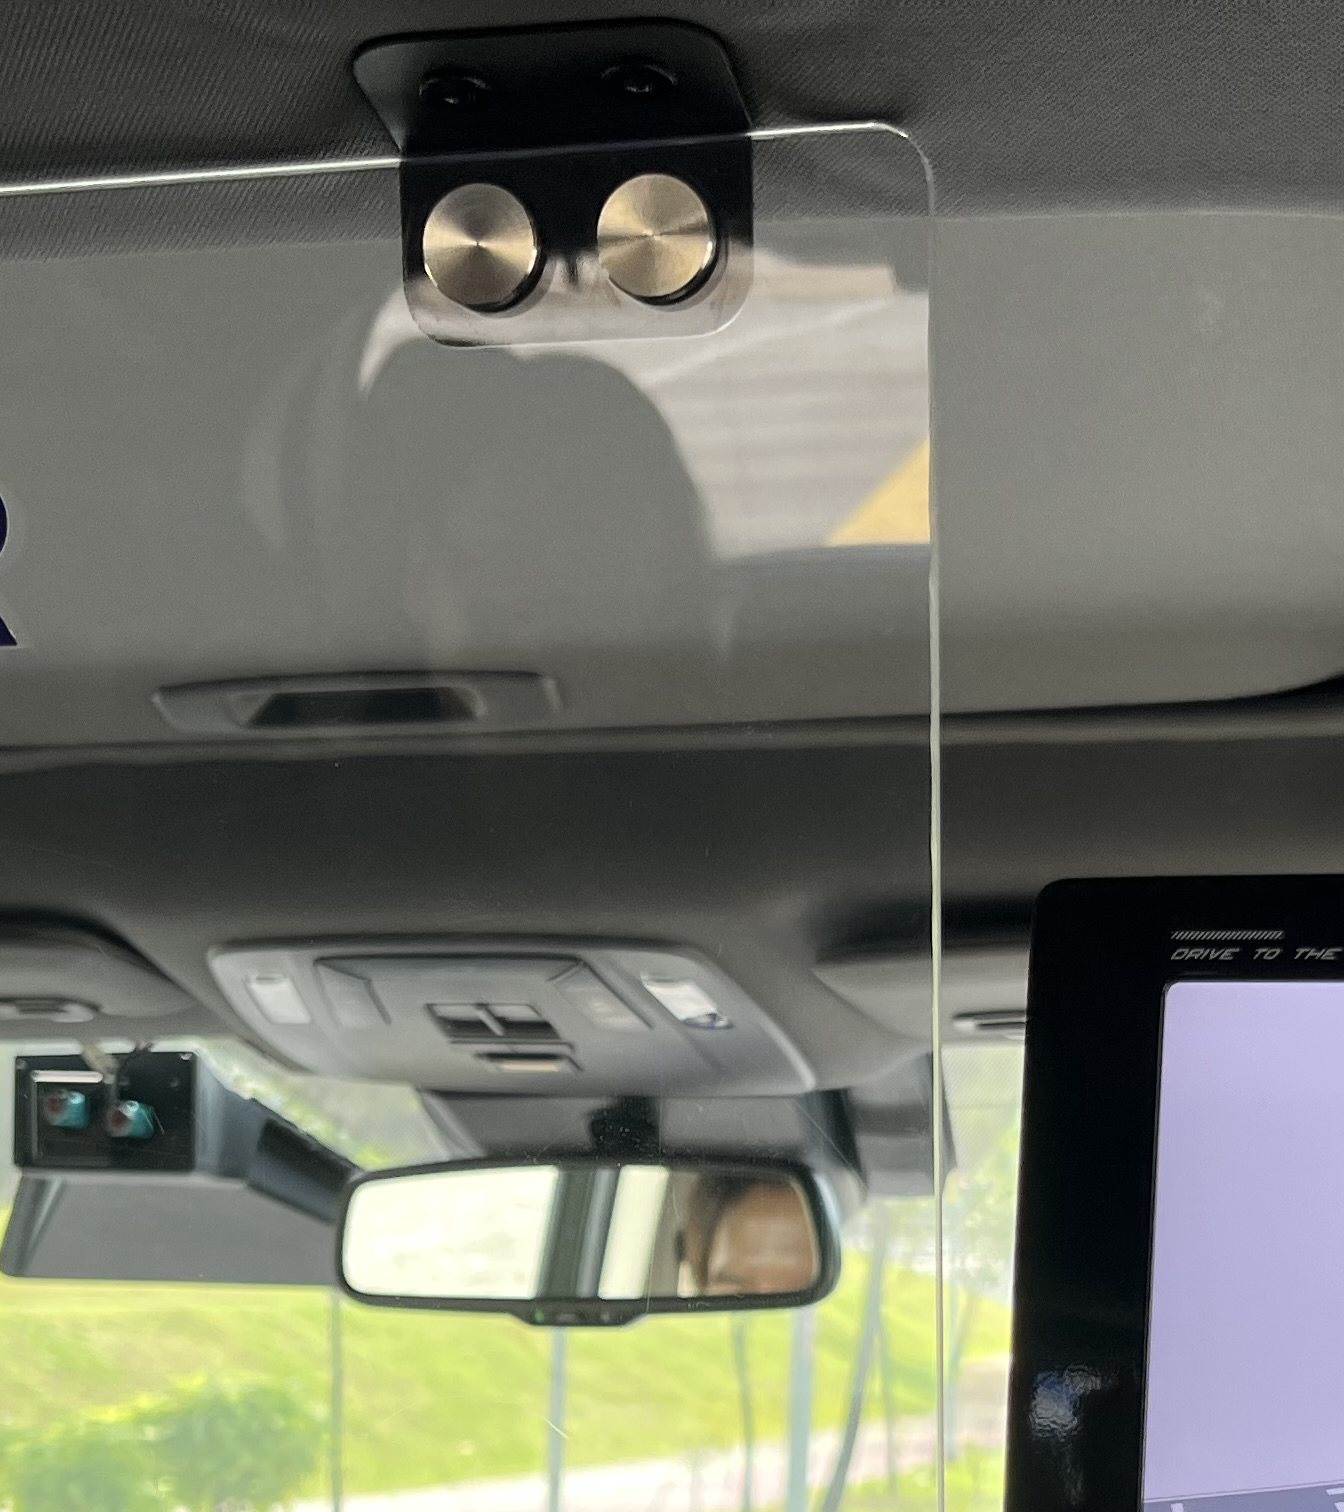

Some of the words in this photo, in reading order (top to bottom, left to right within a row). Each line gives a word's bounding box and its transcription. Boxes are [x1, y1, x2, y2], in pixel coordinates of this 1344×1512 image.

[1170, 947, 1240, 961] DRIVE
[1252, 947, 1281, 961] TO
[1293, 947, 1343, 961] THE
